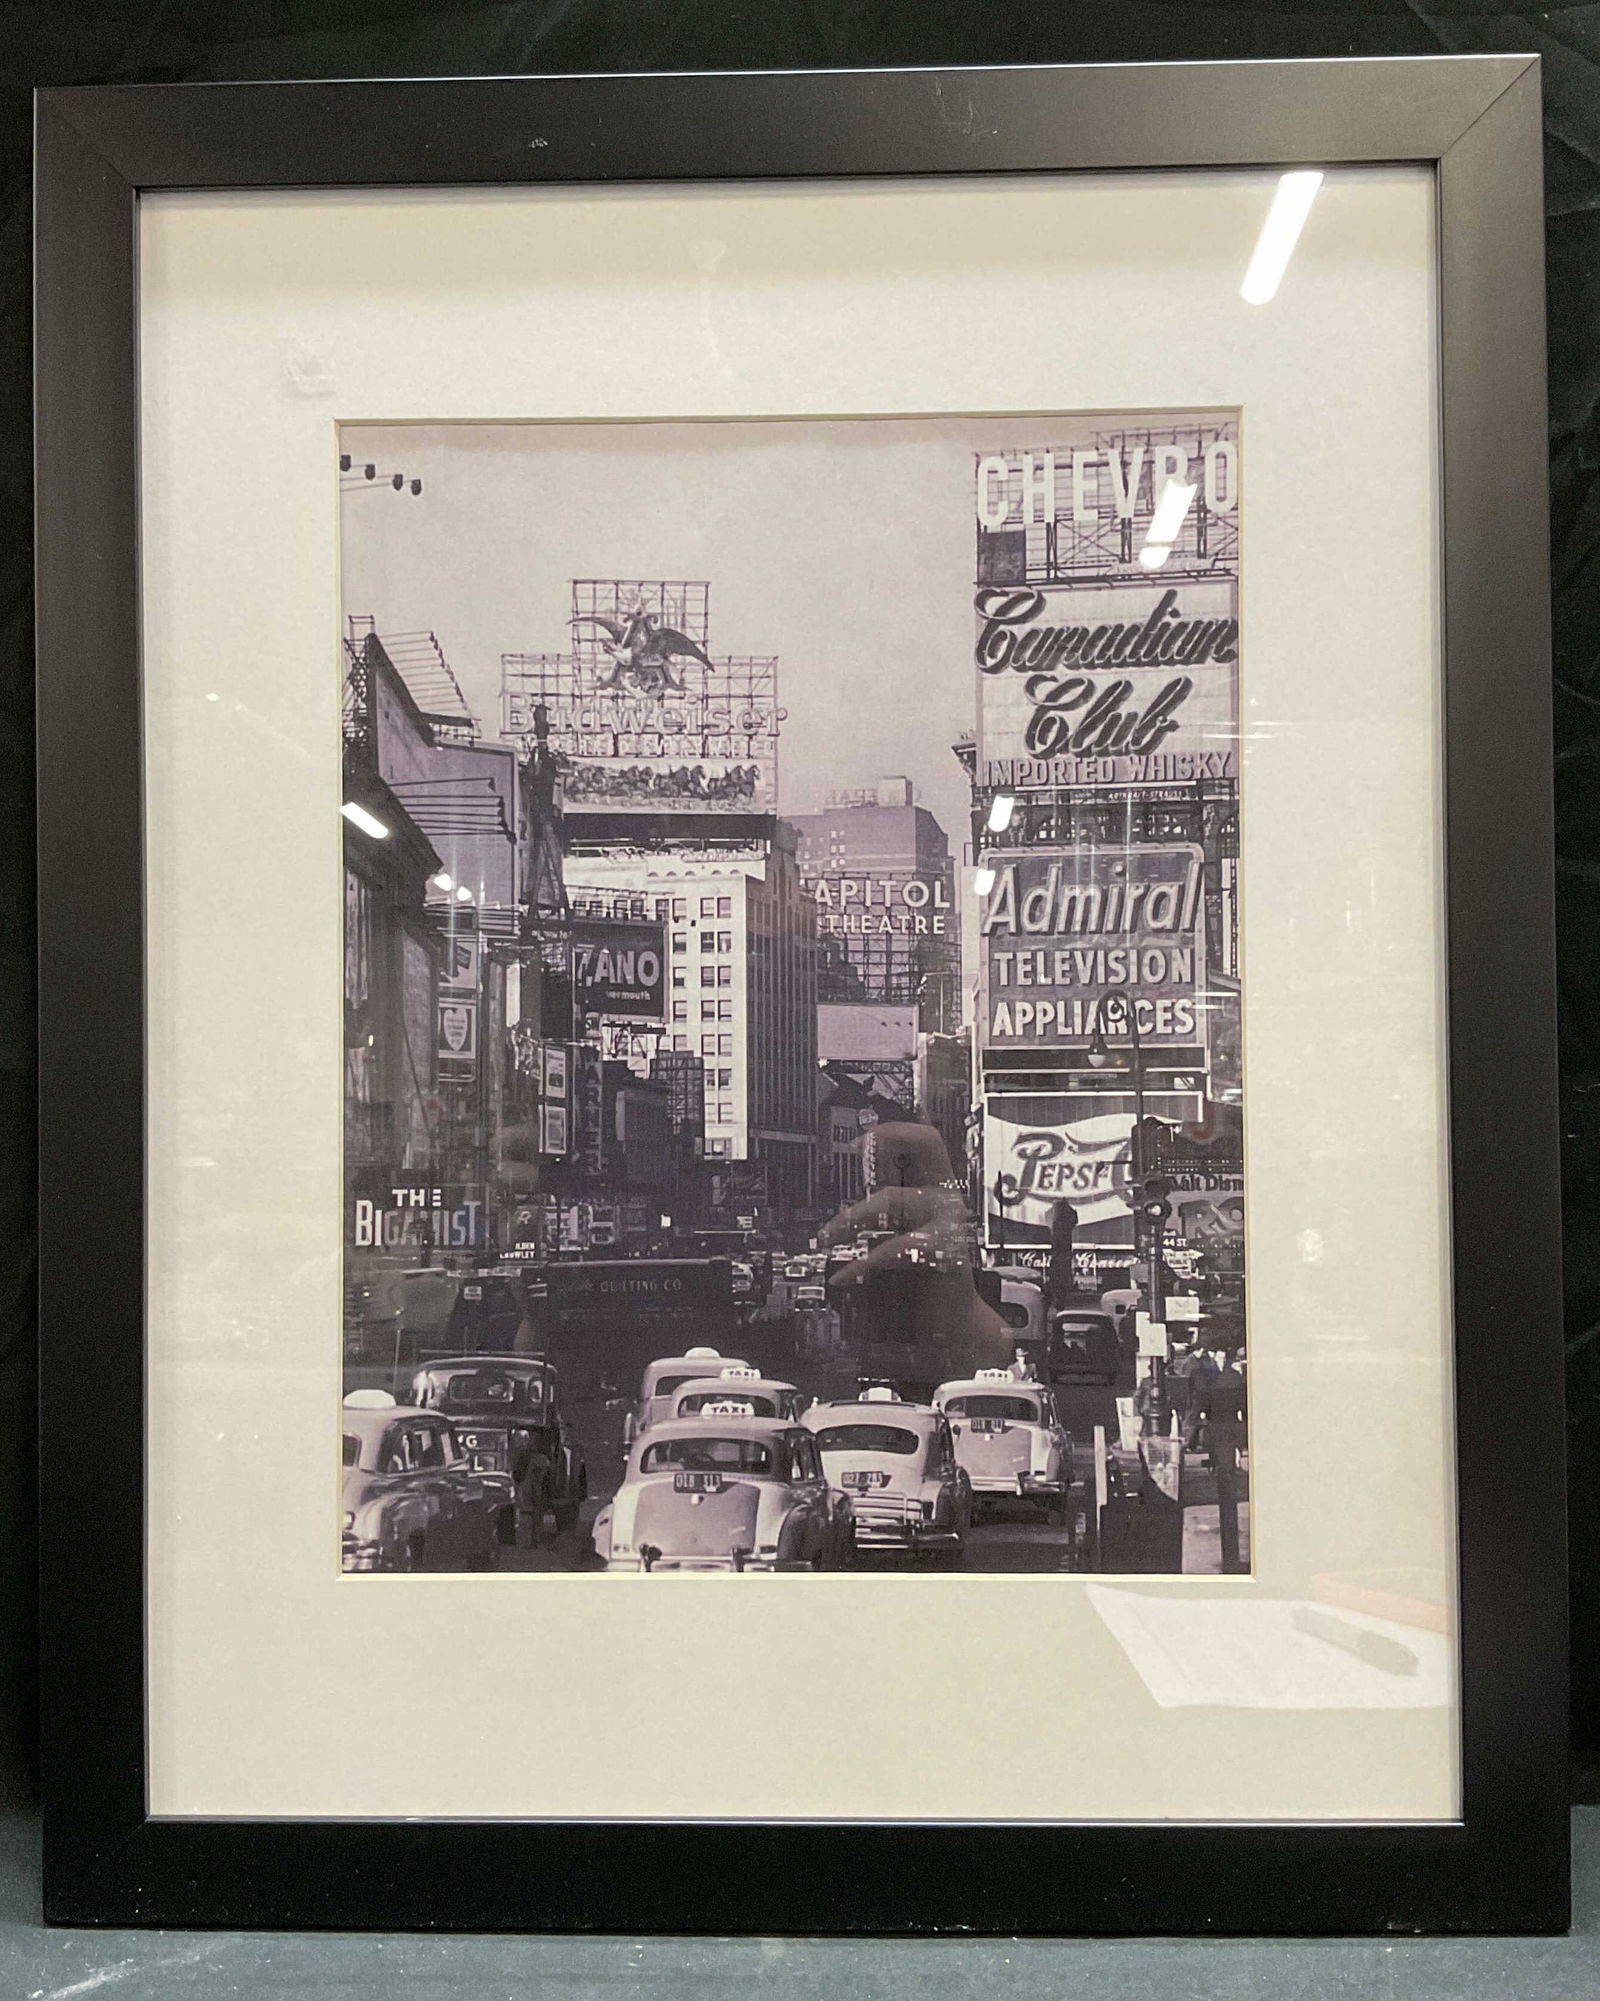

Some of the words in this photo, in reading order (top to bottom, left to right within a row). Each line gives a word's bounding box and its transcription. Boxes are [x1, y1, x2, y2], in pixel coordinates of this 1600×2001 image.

[976, 440, 1238, 529] CHEVRO
[974, 588, 1238, 673] Canadian
[1024, 674, 1193, 760] Club
[983, 757, 1116, 786] IMPORTED
[1127, 751, 1232, 782] WHISKY
[980, 859, 1200, 935] Admiral
[825, 914, 945, 935] THEATRE
[993, 949, 1194, 986] TELEVISION
[992, 999, 1196, 1036] APPLIANCES
[392, 1189, 441, 1207] THE
[1163, 1238, 1175, 1246] 44
[711, 1405, 746, 1413] TAXI
